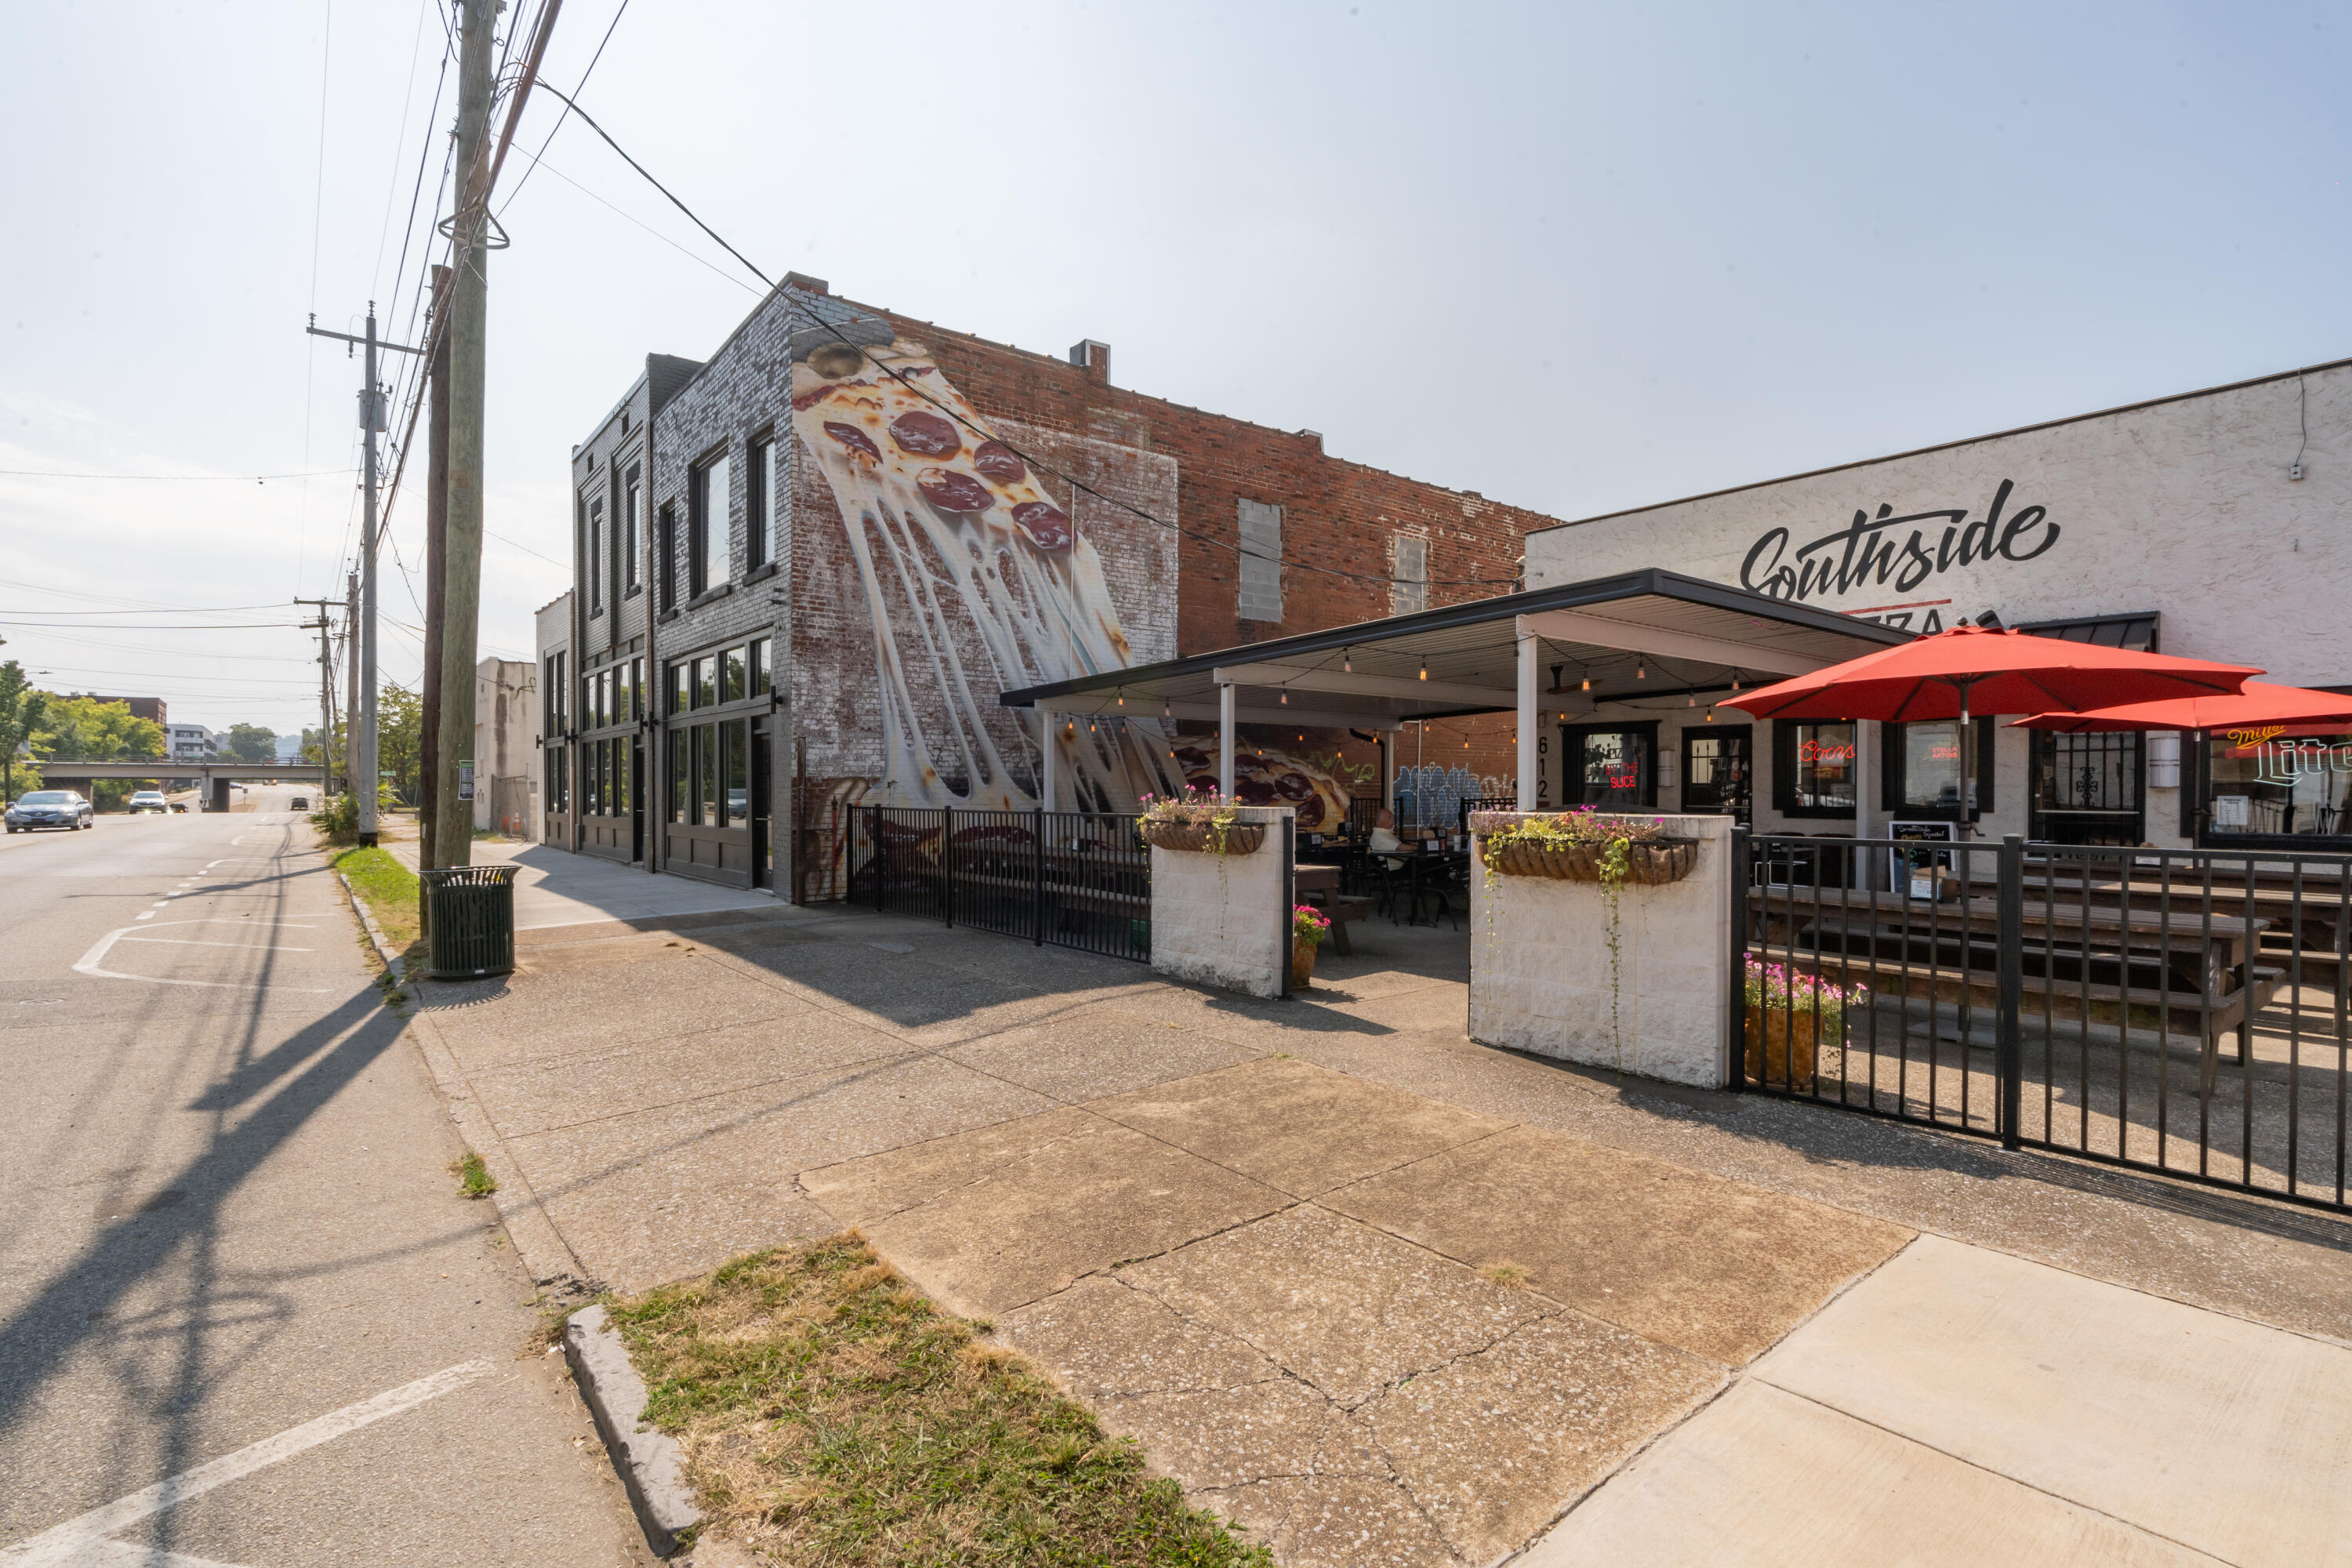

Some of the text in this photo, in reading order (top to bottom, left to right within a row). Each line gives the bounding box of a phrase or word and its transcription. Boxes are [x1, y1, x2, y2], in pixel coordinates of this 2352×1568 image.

[1740, 478, 2061, 602] Southside
[2227, 725, 2286, 749] Miller
[1799, 740, 1856, 762] Coors
[2252, 739, 2352, 787] Lite
[1538, 736, 1548, 798] 612
[1605, 761, 1638, 775] BY THE
[1610, 775, 1636, 789] SLICE
